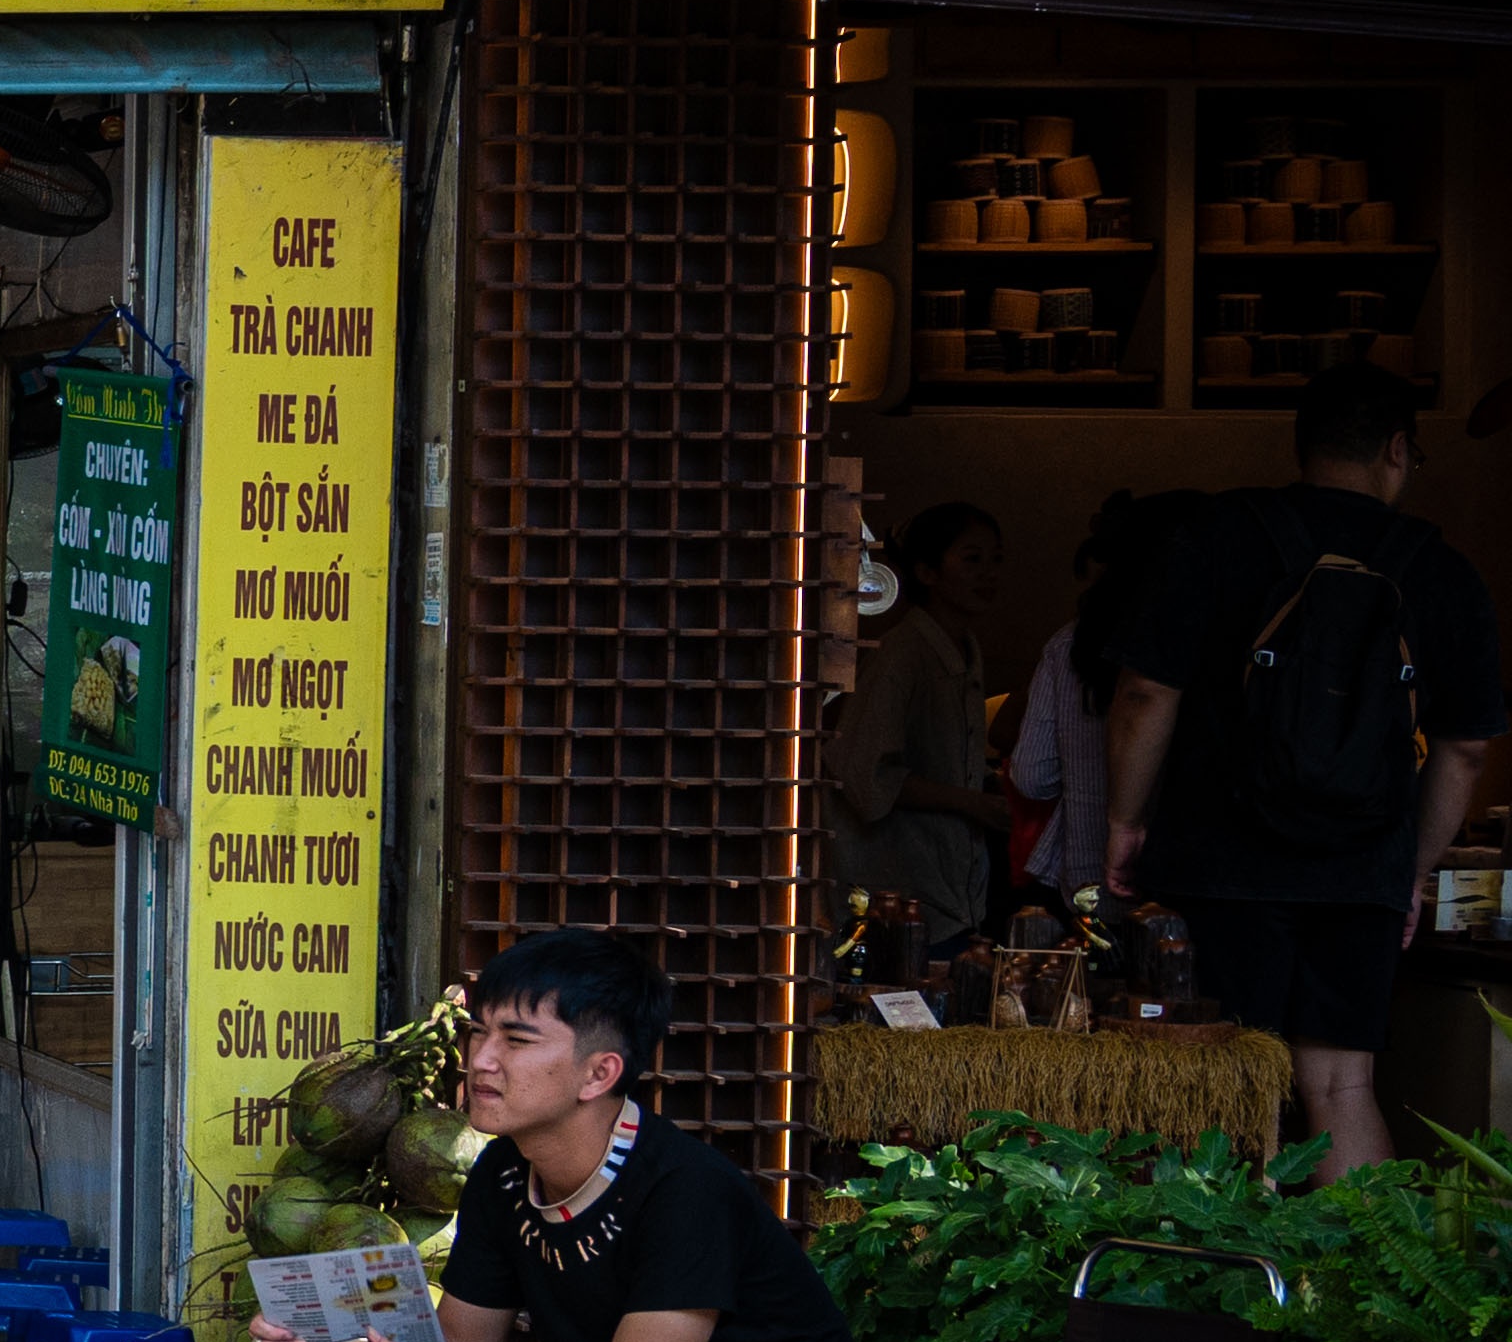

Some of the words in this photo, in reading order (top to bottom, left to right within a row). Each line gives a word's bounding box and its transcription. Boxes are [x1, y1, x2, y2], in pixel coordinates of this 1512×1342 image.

[273, 217, 336, 268] CAFE
[230, 294, 279, 356] TRÀ
[286, 305, 374, 358] CHANH
[141, 389, 169, 425] Th
[257, 393, 297, 444] ME
[304, 384, 340, 445] ĐÁ
[85, 439, 149, 486] CHUYÊN:
[59, 490, 90, 550] CỐM
[106, 506, 127, 559] XÔI
[131, 504, 169, 565] CỐM
[241, 472, 291, 543] BỘT
[296, 464, 350, 534] SẮN
[70, 560, 107, 616] LÀNG
[113, 570, 151, 626] VÒNG
[234, 565, 277, 620] MƠ
[283, 554, 350, 622] MUỐI
[232, 653, 274, 708] MƠ
[282, 657, 349, 721] NGỌT
[69, 754, 92, 780] 094
[95, 760, 118, 787] 653
[121, 767, 150, 795] 1976
[206, 744, 294, 798] CHANH
[301, 730, 368, 799] MUỐI
[72, 779, 88, 804] 24
[90, 787, 114, 816] Nhà
[208, 832, 296, 885] CHANH
[303, 833, 361, 887] TƯƠI
[215, 912, 285, 973] NƯỚC
[292, 923, 351, 975] CAM
[217, 999, 267, 1059] SỮA
[275, 1009, 342, 1061] CHUA
[233, 1097, 297, 1147] LIPT
